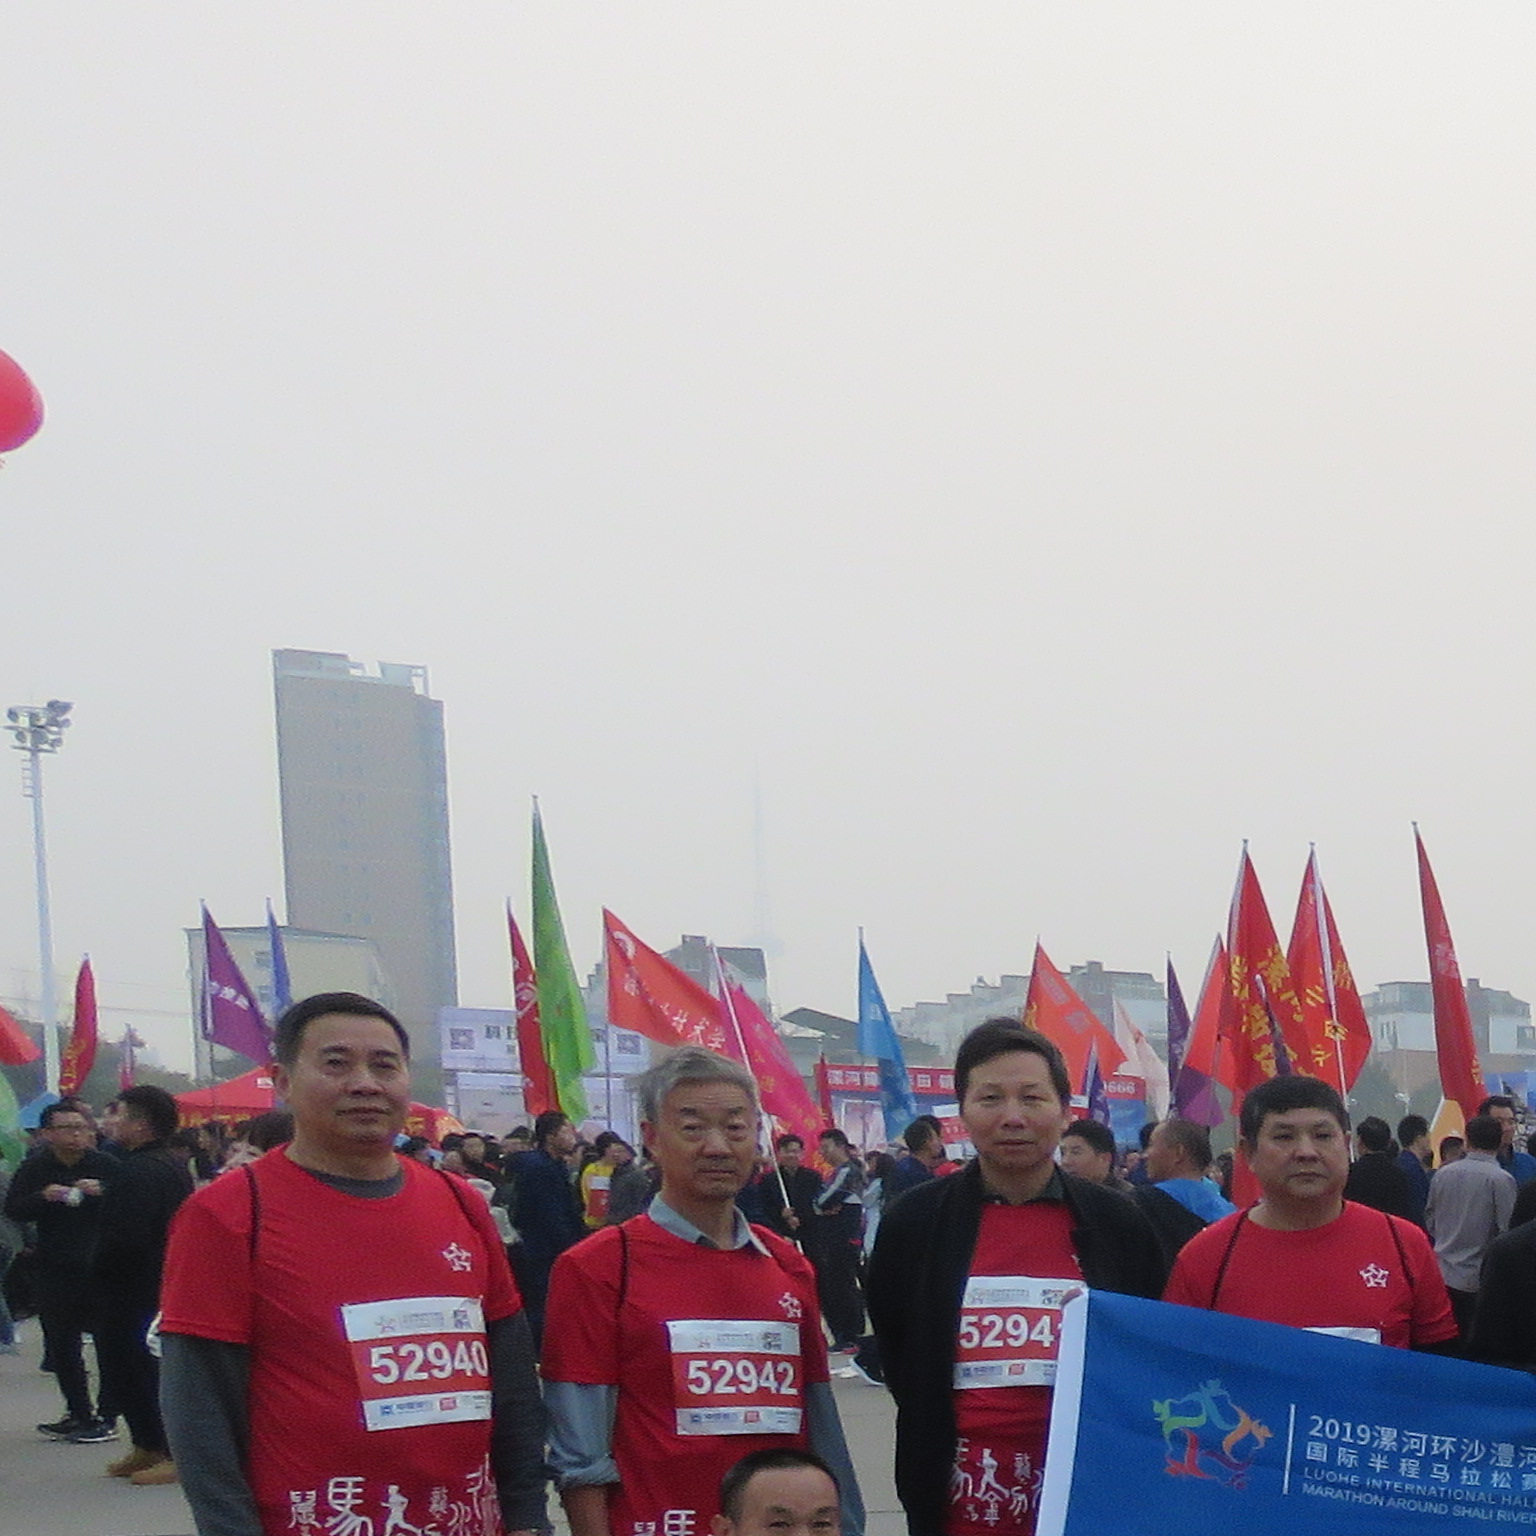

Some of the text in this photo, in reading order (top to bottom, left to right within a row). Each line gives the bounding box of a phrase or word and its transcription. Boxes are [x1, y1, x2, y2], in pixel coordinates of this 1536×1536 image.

[959, 1313, 1062, 1350] 5294
[370, 1340, 489, 1384] 52940
[687, 1359, 799, 1396] 52942
[1302, 1483, 1385, 1507] MARATHON
[1387, 1497, 1449, 1516] AROUND
[1452, 1505, 1494, 1521] SHALI
[1303, 1467, 1360, 1488] LUOHE
[1366, 1477, 1496, 1505] INTERNATIONAL
